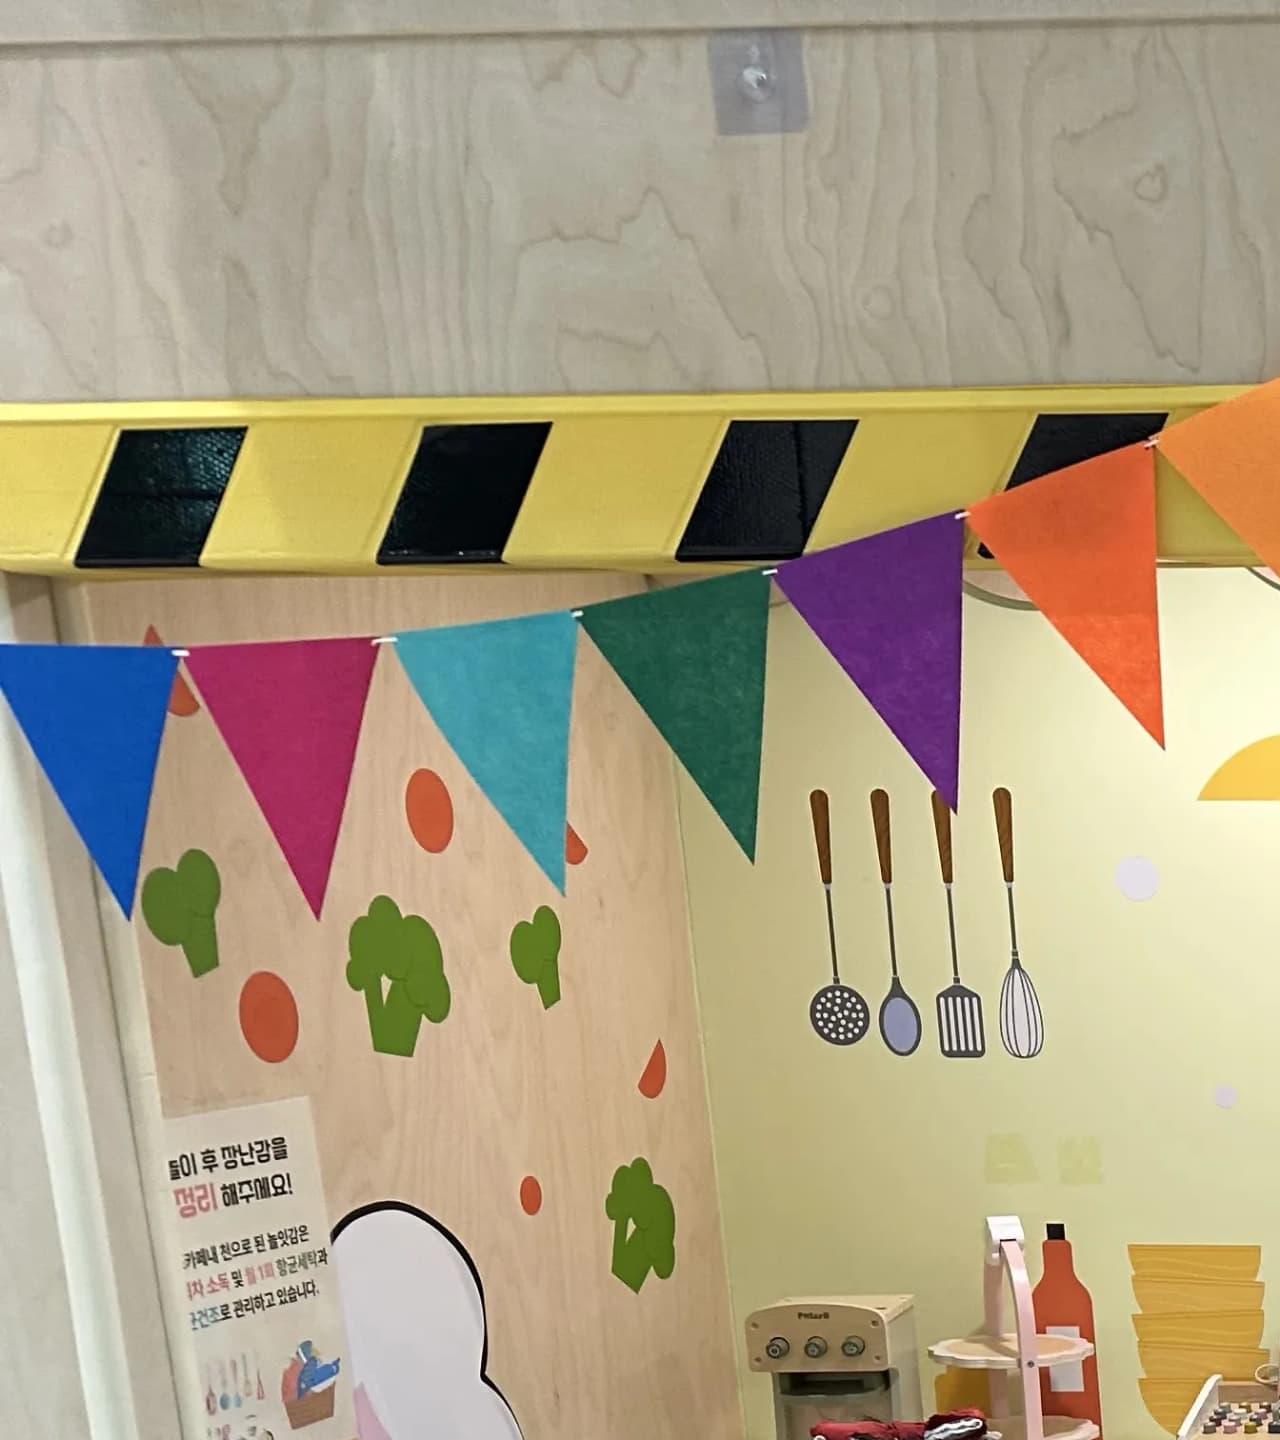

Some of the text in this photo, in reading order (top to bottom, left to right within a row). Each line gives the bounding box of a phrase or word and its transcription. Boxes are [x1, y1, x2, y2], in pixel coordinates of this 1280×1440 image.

[200, 1148, 219, 1173] 후
[220, 1136, 288, 1170] 장난감을
[173, 1173, 293, 1219] 정리 해주세요!
[219, 1236, 253, 1261] 천으로
[254, 1234, 267, 1253] 된
[267, 1225, 310, 1248] 놀잇감은
[206, 1273, 231, 1294] 소독
[231, 1269, 244, 1288] 및
[232, 1292, 275, 1319] 관리하고
